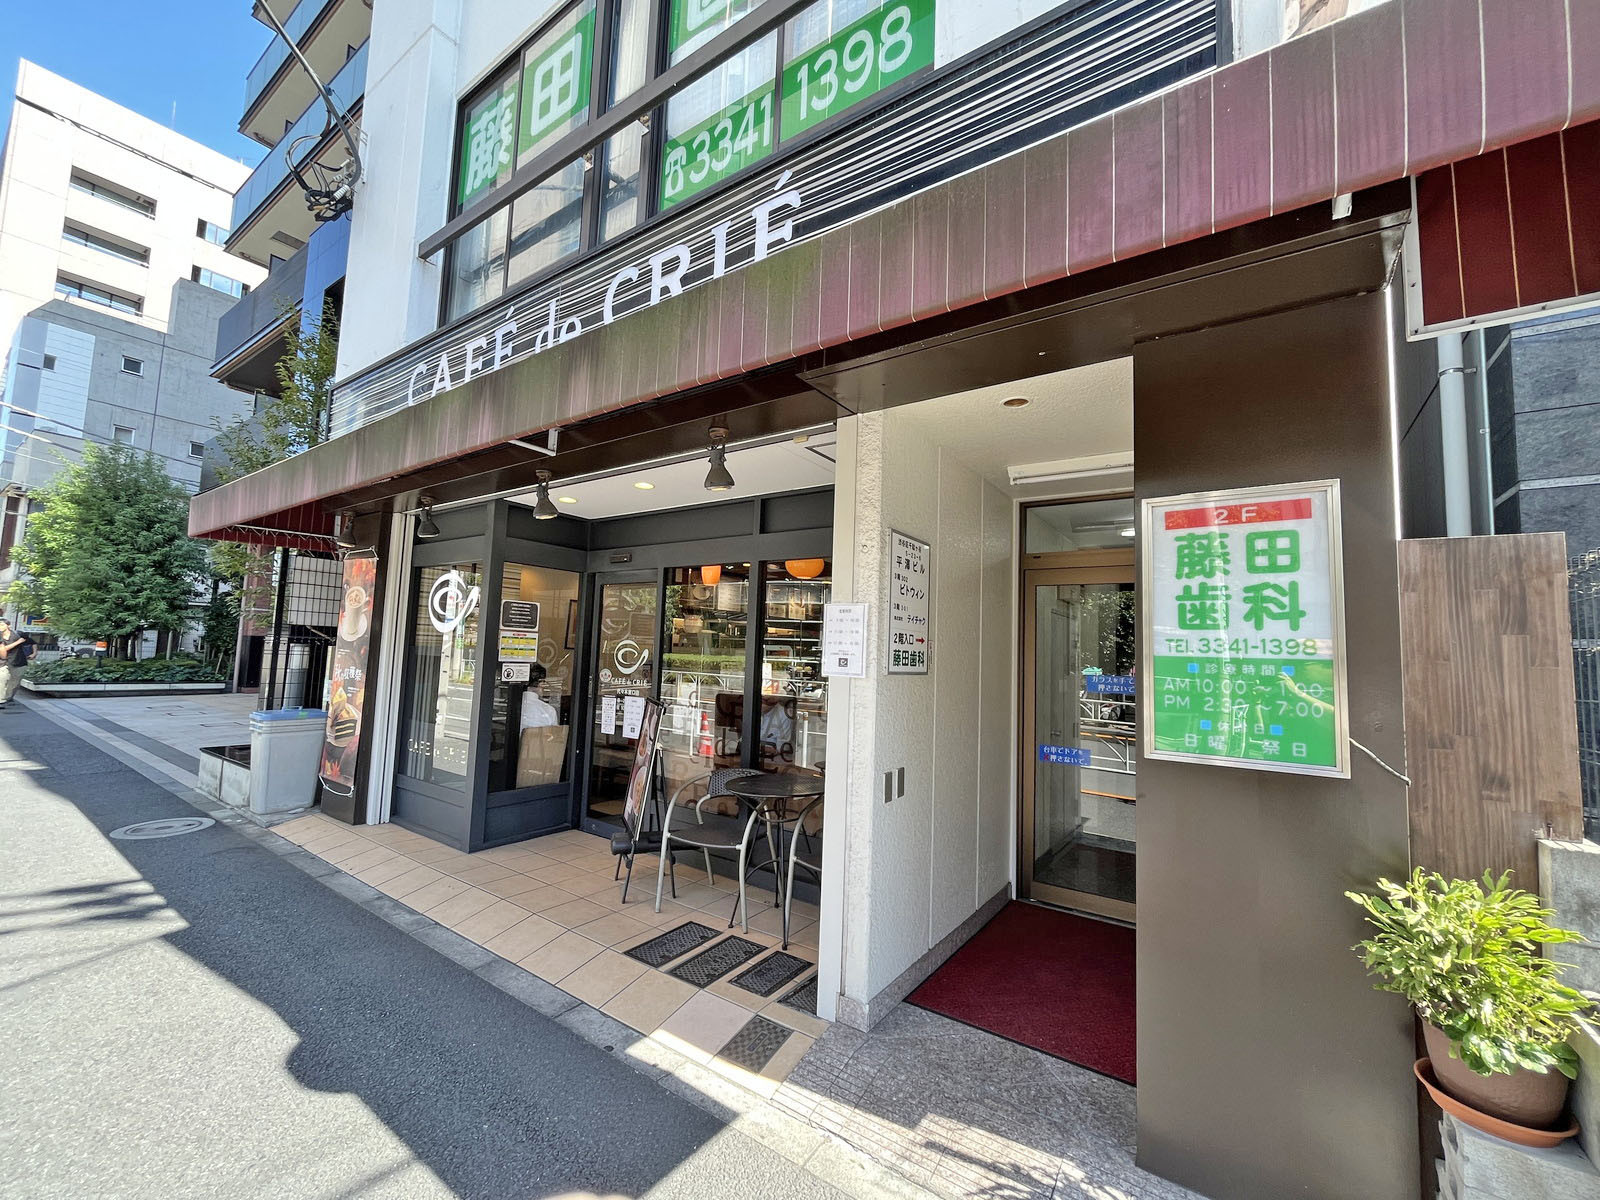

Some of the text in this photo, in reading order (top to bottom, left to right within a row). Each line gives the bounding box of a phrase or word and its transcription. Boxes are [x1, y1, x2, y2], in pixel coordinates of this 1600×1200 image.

[797, 6, 913, 121] 1398
[689, 91, 773, 184] 3341
[408, 169, 801, 407] CAFÉ de CRIÉ
[1198, 638, 1319, 656] 3341-1398
[893, 649, 925, 667] 藤田歯科
[1204, 663, 1276, 677] 診療時間
[1163, 677, 1190, 692] AM
[1164, 695, 1191, 710] PM
